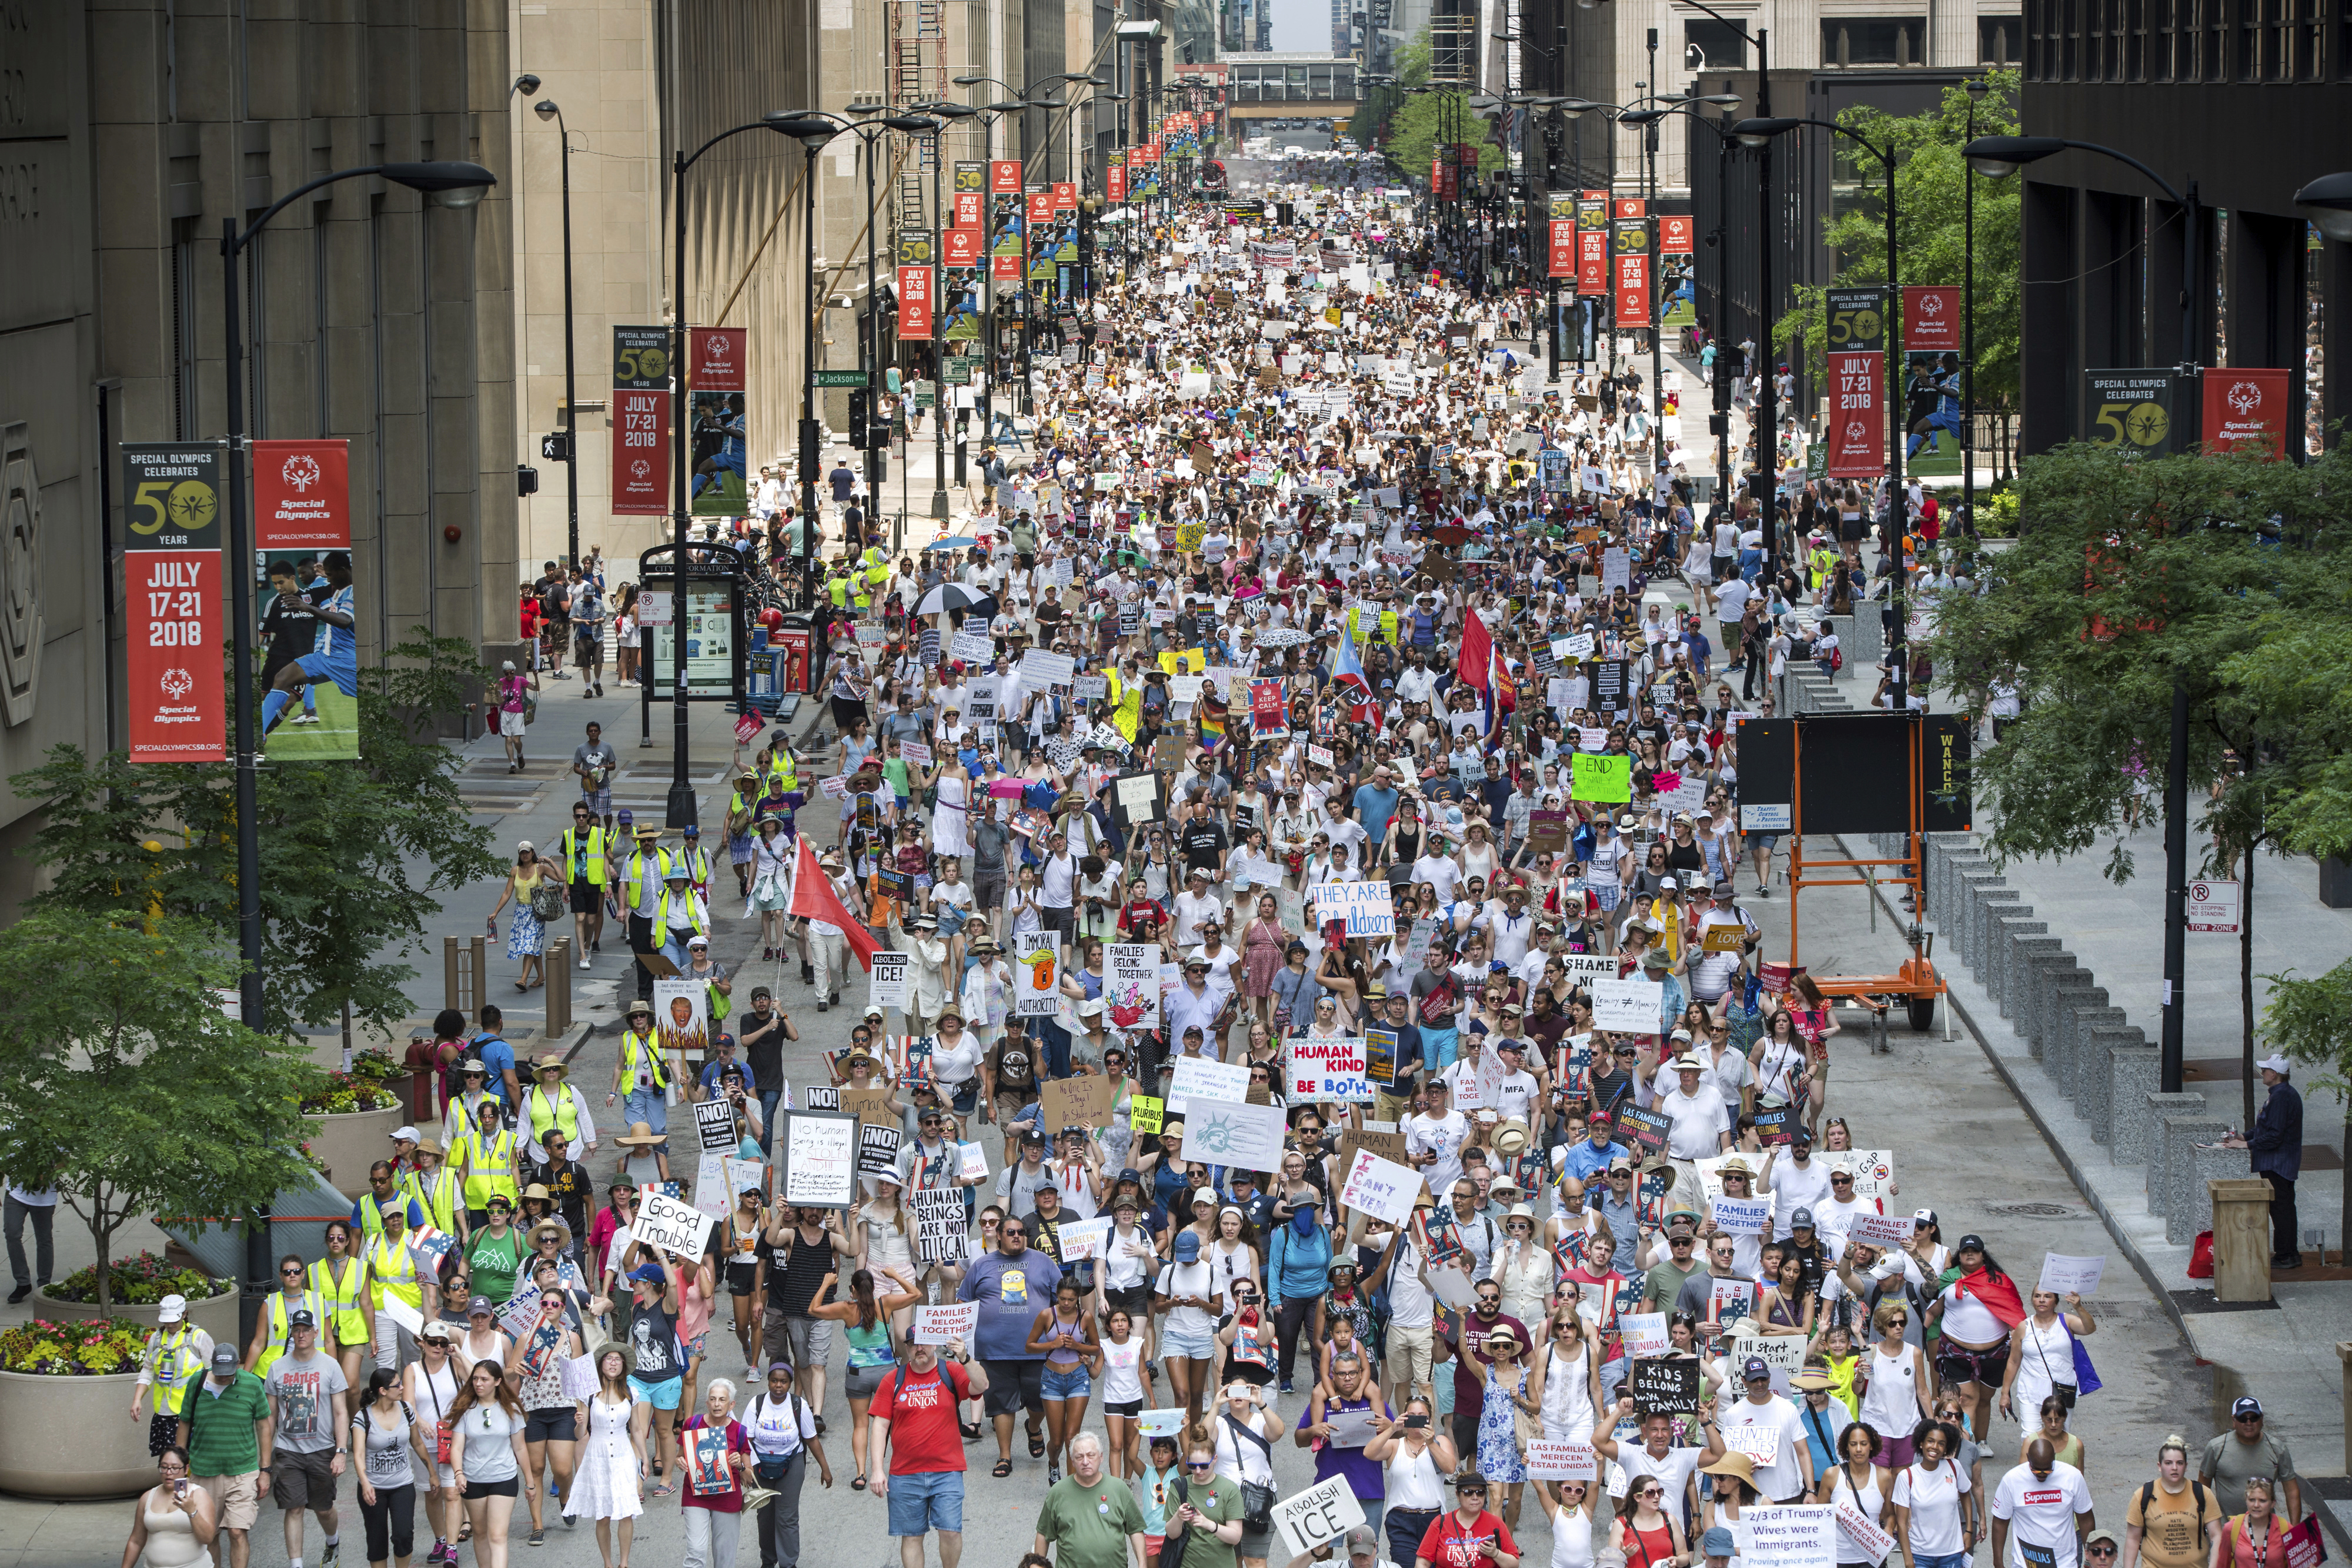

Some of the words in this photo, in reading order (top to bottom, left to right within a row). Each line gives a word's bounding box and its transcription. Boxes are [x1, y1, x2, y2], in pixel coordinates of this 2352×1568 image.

[1623, 259, 1641, 268] JULY
[906, 270, 924, 279] JULY
[1623, 269, 1641, 278] 17-21
[906, 280, 924, 289] 17-21
[1623, 279, 1641, 288] 2018
[906, 290, 924, 299] 2018
[1840, 359, 1871, 374] JULY
[826, 375, 853, 383] Jackson
[1841, 376, 1871, 392] 17-21
[626, 397, 657, 412] JULY
[1841, 394, 1871, 409] 2018
[626, 414, 656, 429] 17-21
[626, 432, 656, 446] 2018
[131, 454, 166, 464] SPECIAL
[171, 454, 211, 463] OLYMPICS
[145, 467, 198, 476] CELEBRATES
[282, 500, 325, 509] Special
[275, 510, 330, 520] Olympics
[1178, 523, 1205, 537] PARENTS
[159, 536, 187, 544] YEARS
[1177, 541, 1201, 550] PRISON
[148, 563, 201, 587] JULY
[148, 592, 201, 617] 17-21
[150, 622, 201, 646] 2018
[1586, 758, 1612, 774] END
[1668, 793, 1696, 801] PROTECTION
[1358, 883, 1391, 901] ARE
[1317, 905, 1396, 934] Cildren
[1024, 934, 1054, 951] IMMORAL
[1110, 947, 1144, 957] FAMILIES
[1114, 958, 1140, 968] BELONG
[1565, 958, 1618, 971] SHAME!
[876, 967, 903, 981] ICE!
[1118, 969, 1153, 979] TOGETHER
[1762, 972, 1786, 981] FAMILIES
[1018, 998, 1058, 1014] AUTHORITY
[1295, 1046, 1352, 1059] HUMAN
[1326, 1059, 1365, 1072] KIND
[1060, 1084, 1067, 1094] No
[1069, 1083, 1080, 1094] One
[1081, 1081, 1093, 1091] Is
[1297, 1081, 1315, 1092] BE
[1325, 1079, 1372, 1094] BOTH.
[1067, 1092, 1089, 1107] Illegal
[1145, 1098, 1149, 1107] E
[697, 1103, 729, 1122] ¡NO!
[1063, 1111, 1070, 1122] On
[1071, 1108, 1087, 1121] Stolen
[1091, 1106, 1102, 1117] Land
[1133, 1108, 1162, 1121] PLURIBUS
[1623, 1106, 1635, 1116] LAS
[1635, 1111, 1668, 1128] FAMILIAS
[793, 1118, 811, 1134] No
[816, 1121, 847, 1135] human
[1137, 1121, 1155, 1132] UNUM
[1621, 1115, 1651, 1132] MERECEN
[1618, 1124, 1636, 1136] ESTAR
[1638, 1131, 1663, 1145] UNIDAS
[793, 1134, 813, 1148] being
[828, 1137, 847, 1150] illegal
[807, 1148, 851, 1160] STOLEN
[791, 1160, 833, 1171] LAND!!!
[1355, 1154, 1375, 1172] I
[1352, 1171, 1395, 1197] CAN'T
[916, 1189, 961, 1206] HUMAN
[1345, 1186, 1387, 1215] EVEN
[649, 1197, 700, 1231] Good
[918, 1206, 963, 1222] BEINGS
[1716, 1203, 1766, 1216] FAMILIES
[1715, 1216, 1763, 1228] TOGETHER
[920, 1222, 940, 1237] ARE
[946, 1221, 967, 1236] NOT
[637, 1216, 697, 1256] Trouble
[920, 1238, 969, 1263] ILLEGAL
[926, 1306, 971, 1317] FAMILIES
[932, 1317, 966, 1325] BELONG
[921, 1323, 973, 1334] TOGETHER
[283, 1373, 320, 1386] BEATLES
[1639, 1379, 1682, 1392] BELONG
[908, 1389, 937, 1399] TEACHERS
[908, 1396, 937, 1407] UNION
[1649, 1398, 1696, 1412] FAMILY
[1724, 1426, 1780, 1440] REUNITE
[1531, 1443, 1548, 1452] LAS
[2024, 1491, 2062, 1503] Supremo
[1750, 1510, 1768, 1522] 2/3
[1772, 1510, 1782, 1519] of
[1290, 1500, 1345, 1549] ICE
[1753, 1526, 1786, 1534] Wives
[1756, 1540, 1821, 1551] Immigrants.
[1749, 1558, 1779, 1566] Proving
[1805, 1555, 1828, 1564] again
